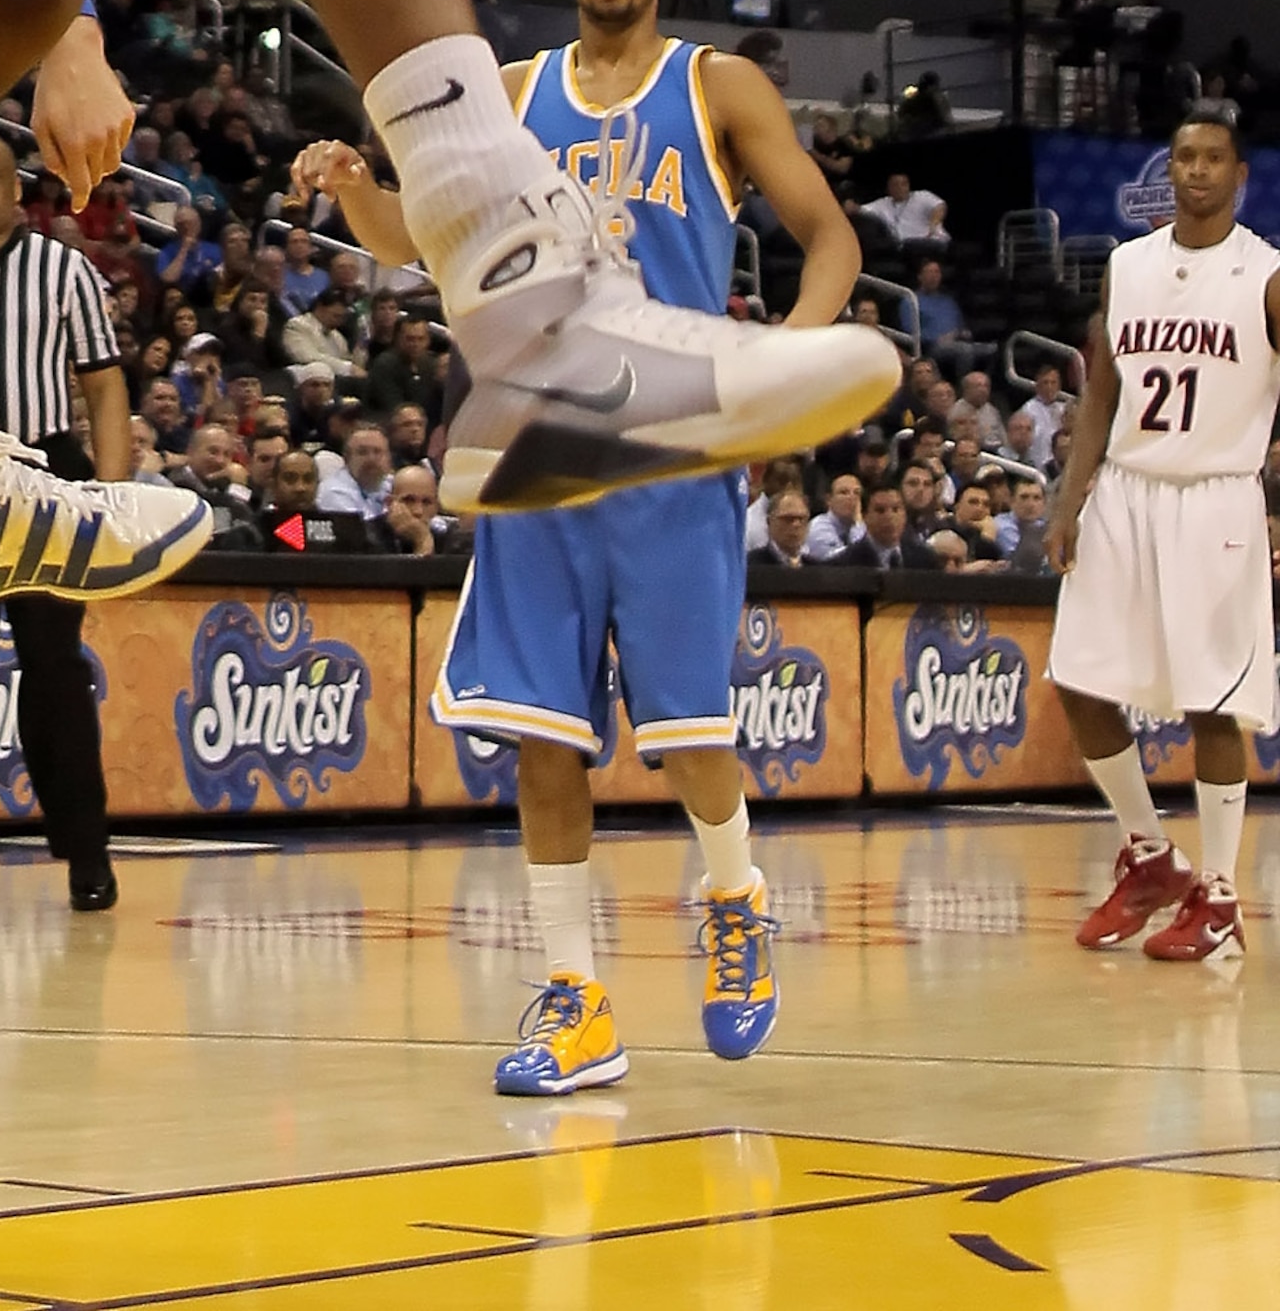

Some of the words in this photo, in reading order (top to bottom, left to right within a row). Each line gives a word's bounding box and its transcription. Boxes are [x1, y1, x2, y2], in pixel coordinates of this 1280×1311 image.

[1113, 317, 1240, 365] ARIZONA
[1140, 365, 1199, 433] 21
[192, 652, 362, 763] Sunkist
[729, 671, 823, 750] nkist
[905, 645, 1023, 741] Sunkist
